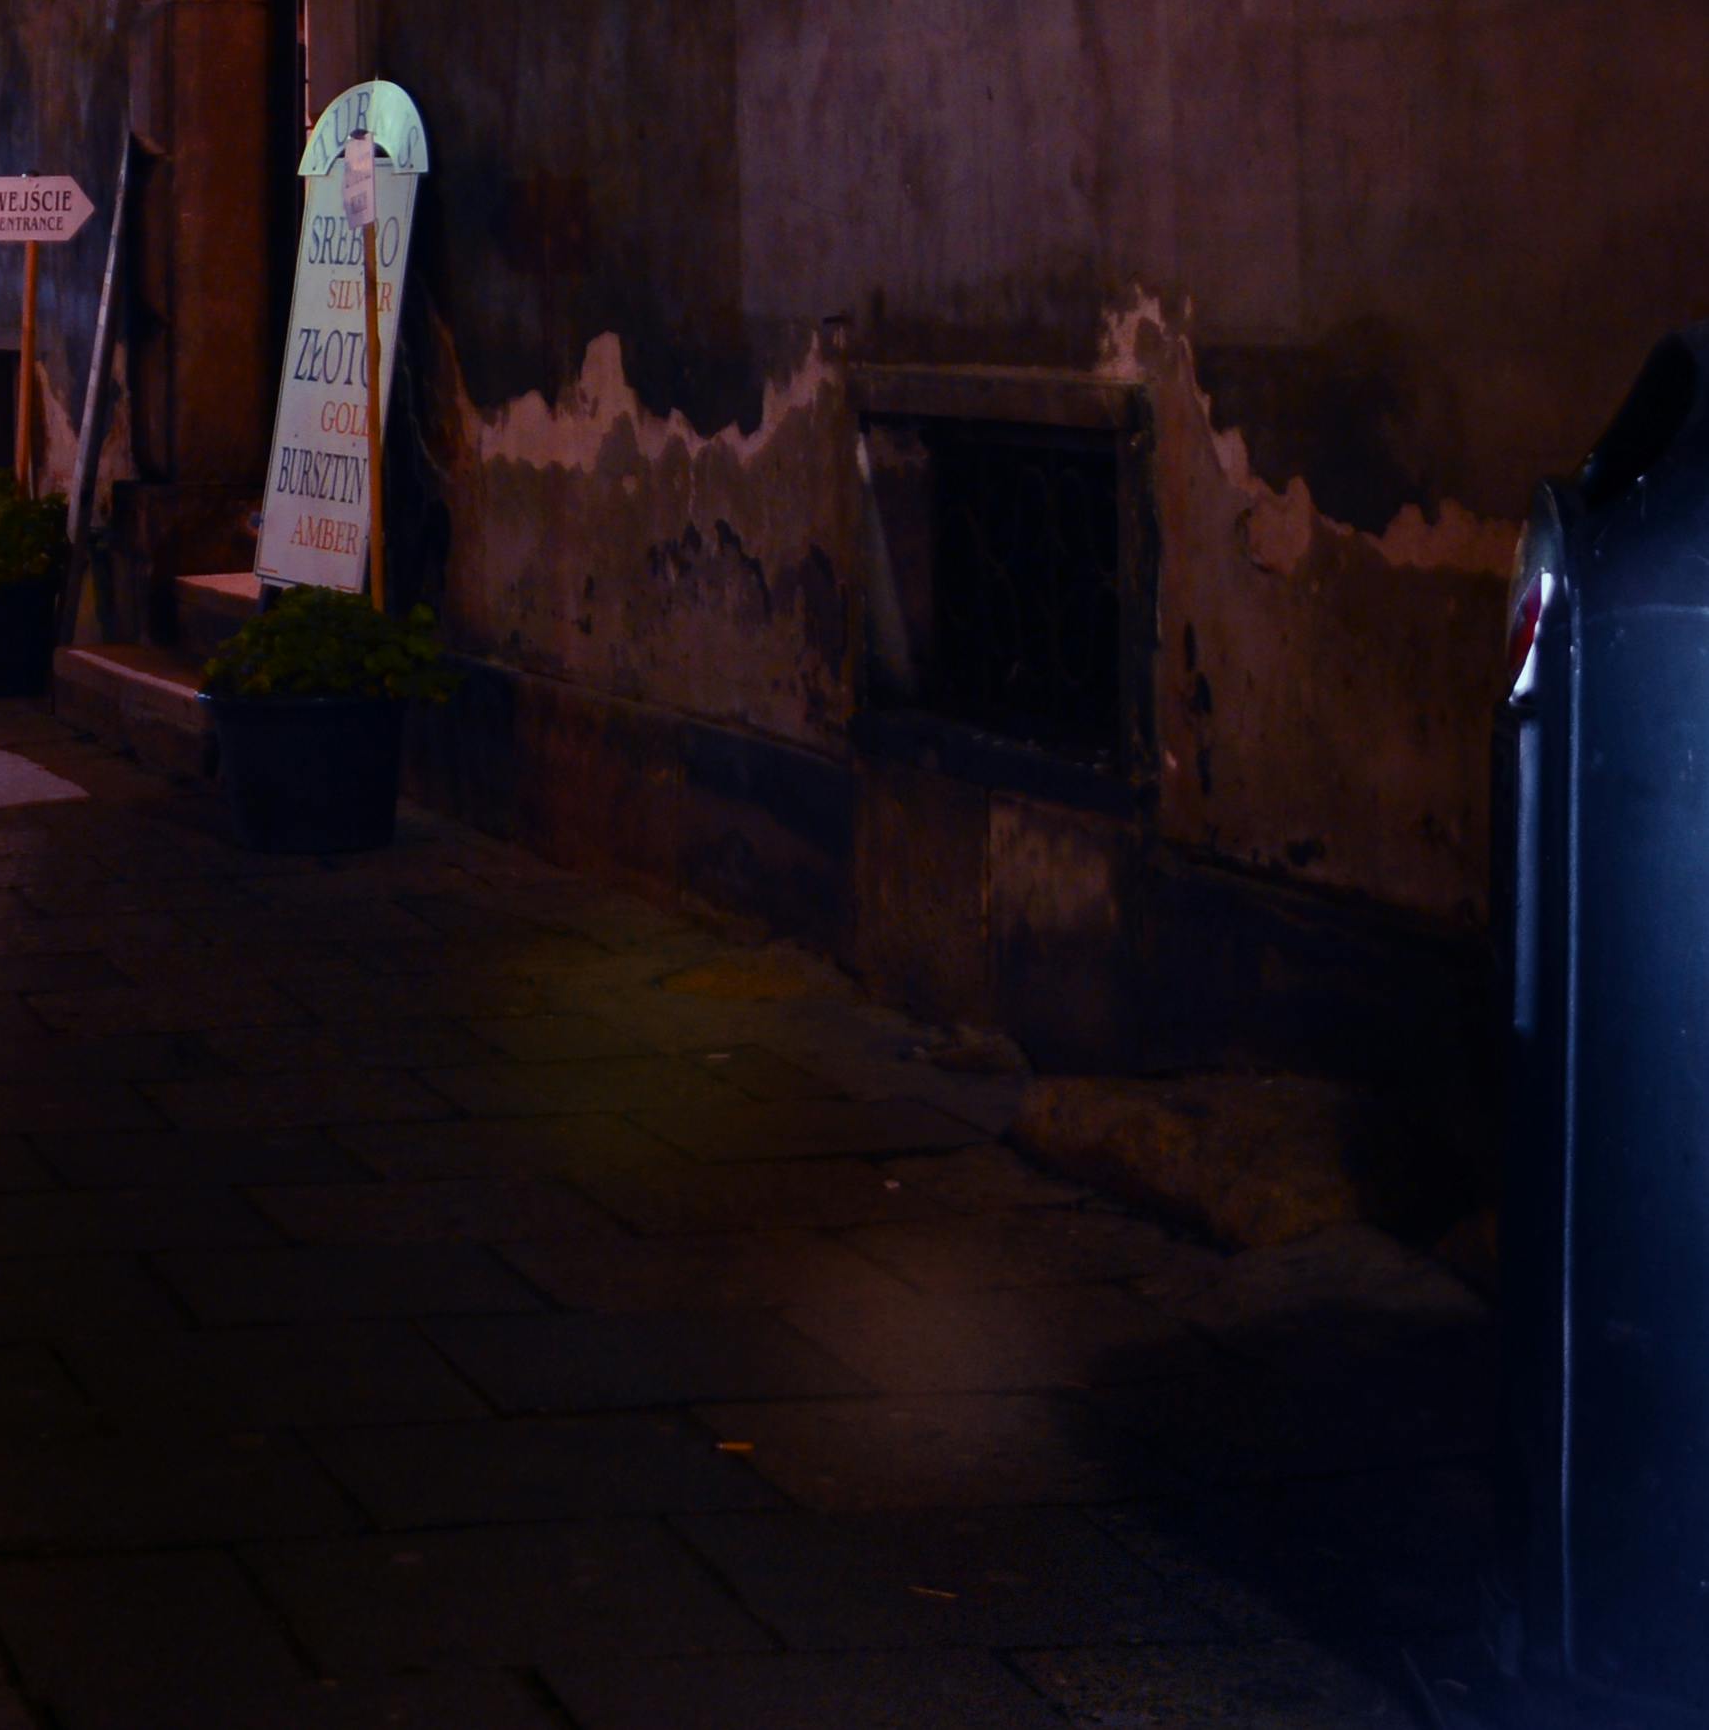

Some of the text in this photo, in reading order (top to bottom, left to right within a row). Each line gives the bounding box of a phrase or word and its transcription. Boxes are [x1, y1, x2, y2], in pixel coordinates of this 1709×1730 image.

[312, 89, 419, 169] TURS
[0, 216, 64, 231] ENTRANCE
[308, 215, 400, 268] SREBO
[326, 279, 393, 313] SILVR
[276, 446, 368, 506] BURSZTYN
[289, 514, 360, 556] AMBER
